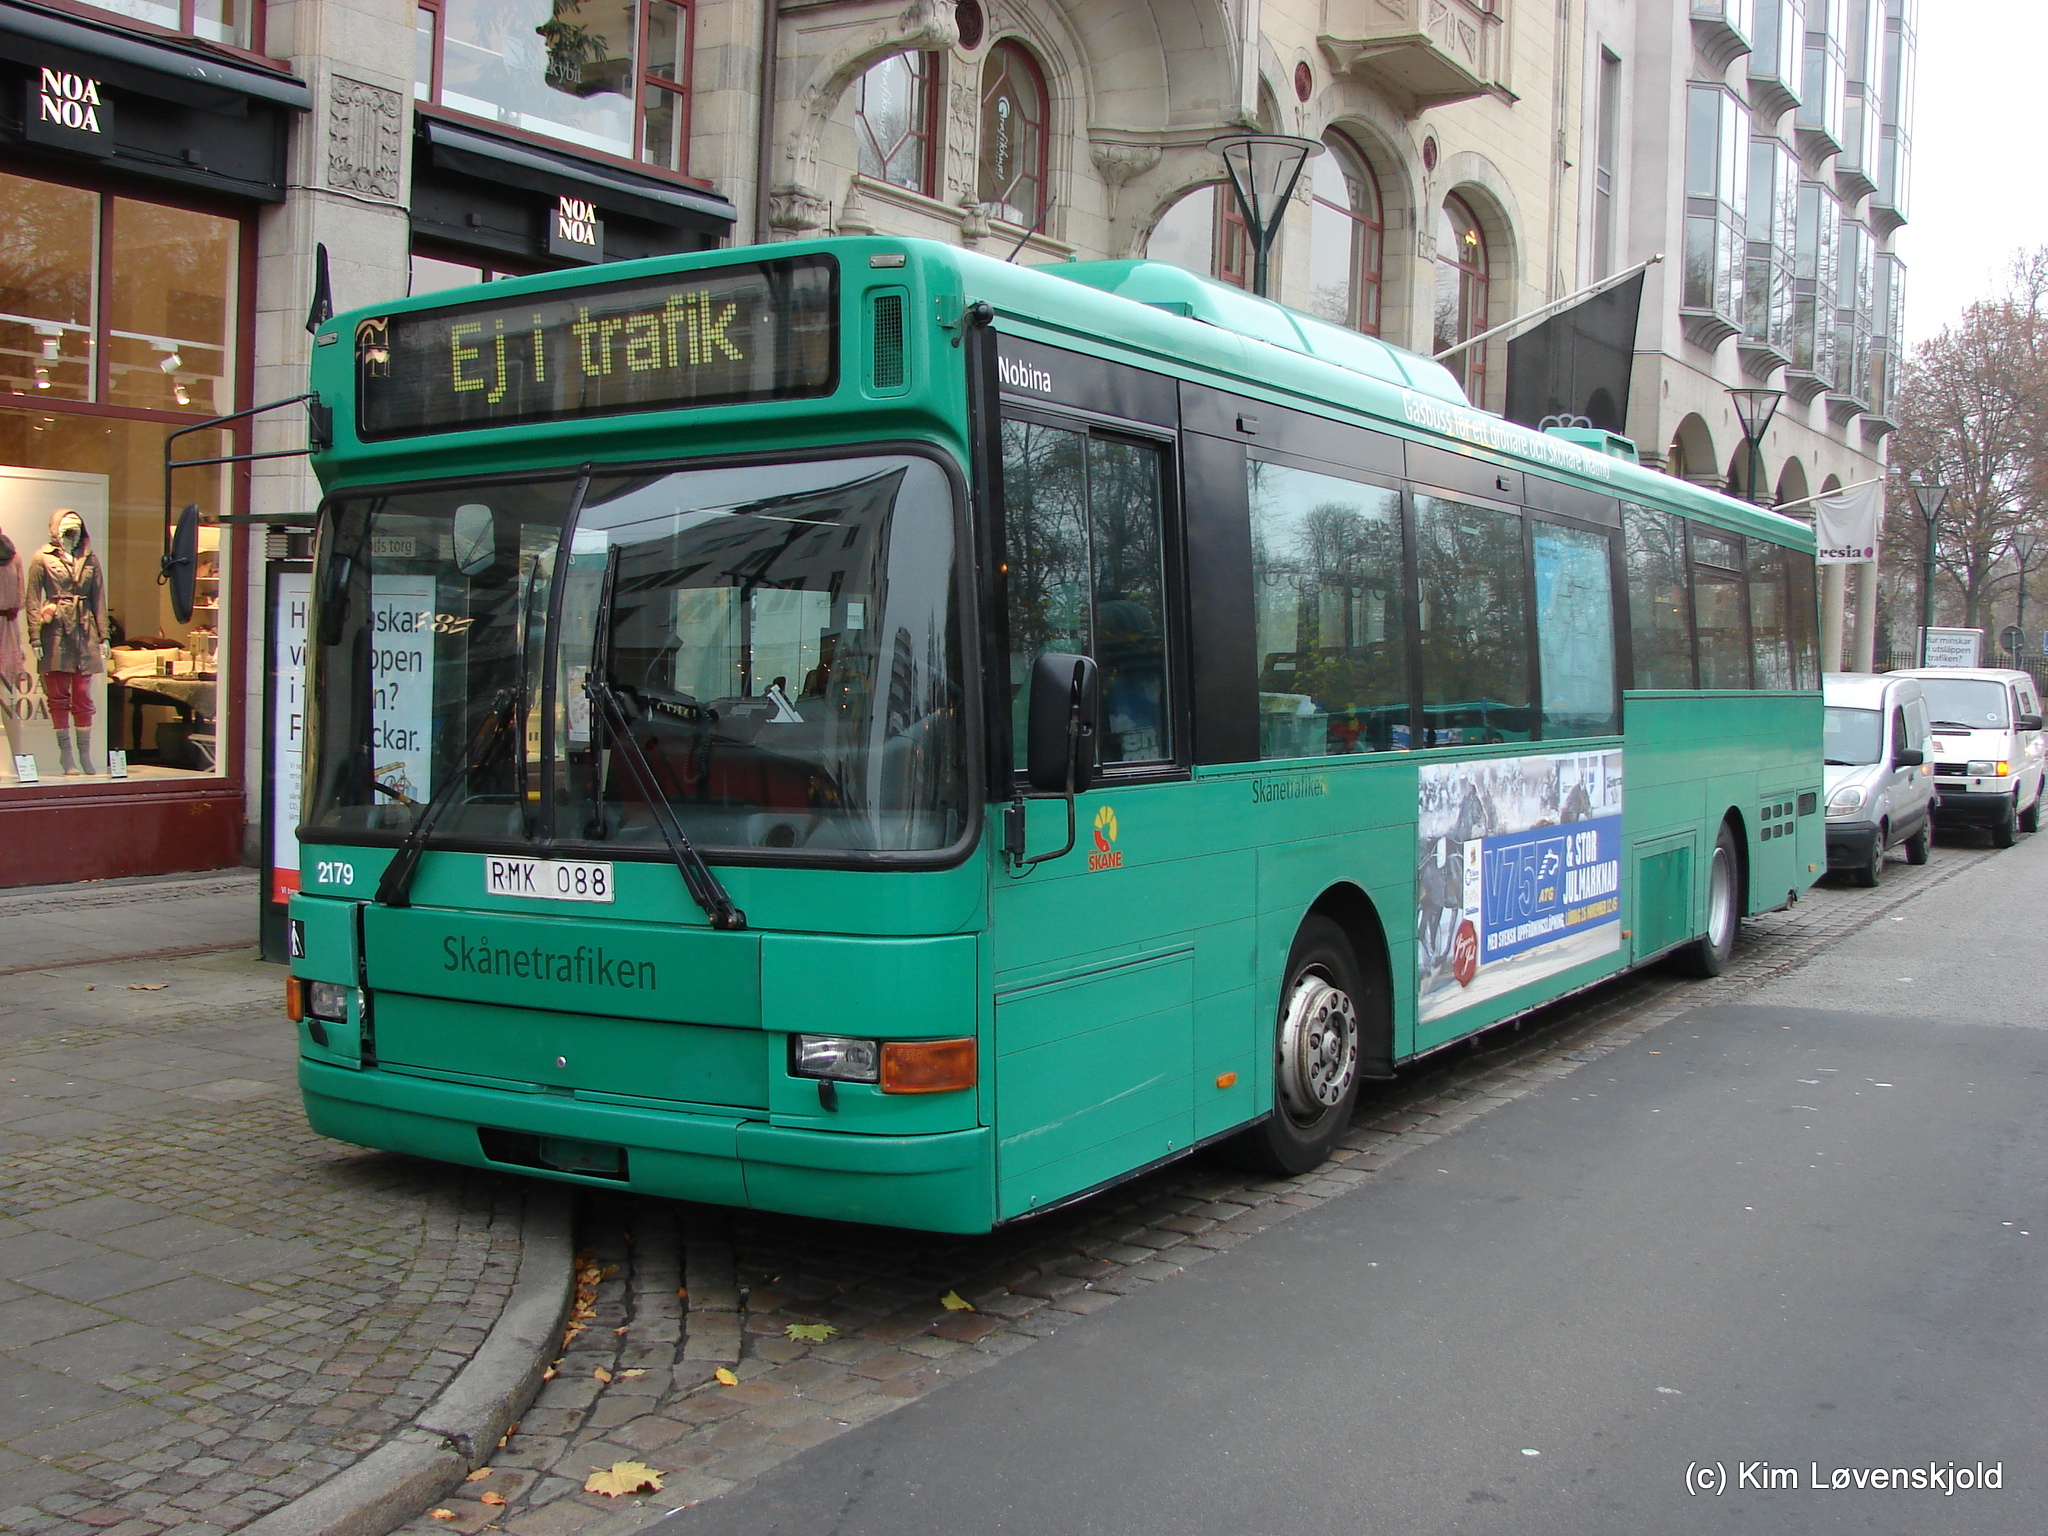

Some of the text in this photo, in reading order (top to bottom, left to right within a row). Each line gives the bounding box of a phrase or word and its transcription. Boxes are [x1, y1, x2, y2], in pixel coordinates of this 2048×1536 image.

[41, 67, 101, 105] NOA
[41, 94, 101, 133] NOA
[559, 196, 597, 224] NOA
[559, 217, 596, 246] NOA
[452, 290, 743, 403] Ej i trafik
[998, 356, 1051, 393] Nobina
[1402, 391, 1453, 433] Gasbuss
[389, 540, 412, 556] torg
[1819, 545, 1862, 558] resia
[290, 638, 306, 666] vi
[1253, 775, 1328, 804] Skånetrafiken
[1566, 830, 1597, 868] & STOR
[318, 862, 354, 886] 2179
[493, 861, 607, 896] RMK 088
[1484, 841, 1536, 926] V75
[1562, 860, 1618, 905] JULMARKNAD
[1538, 886, 1555, 903] ATG
[443, 935, 657, 990] Skånetrafiken
